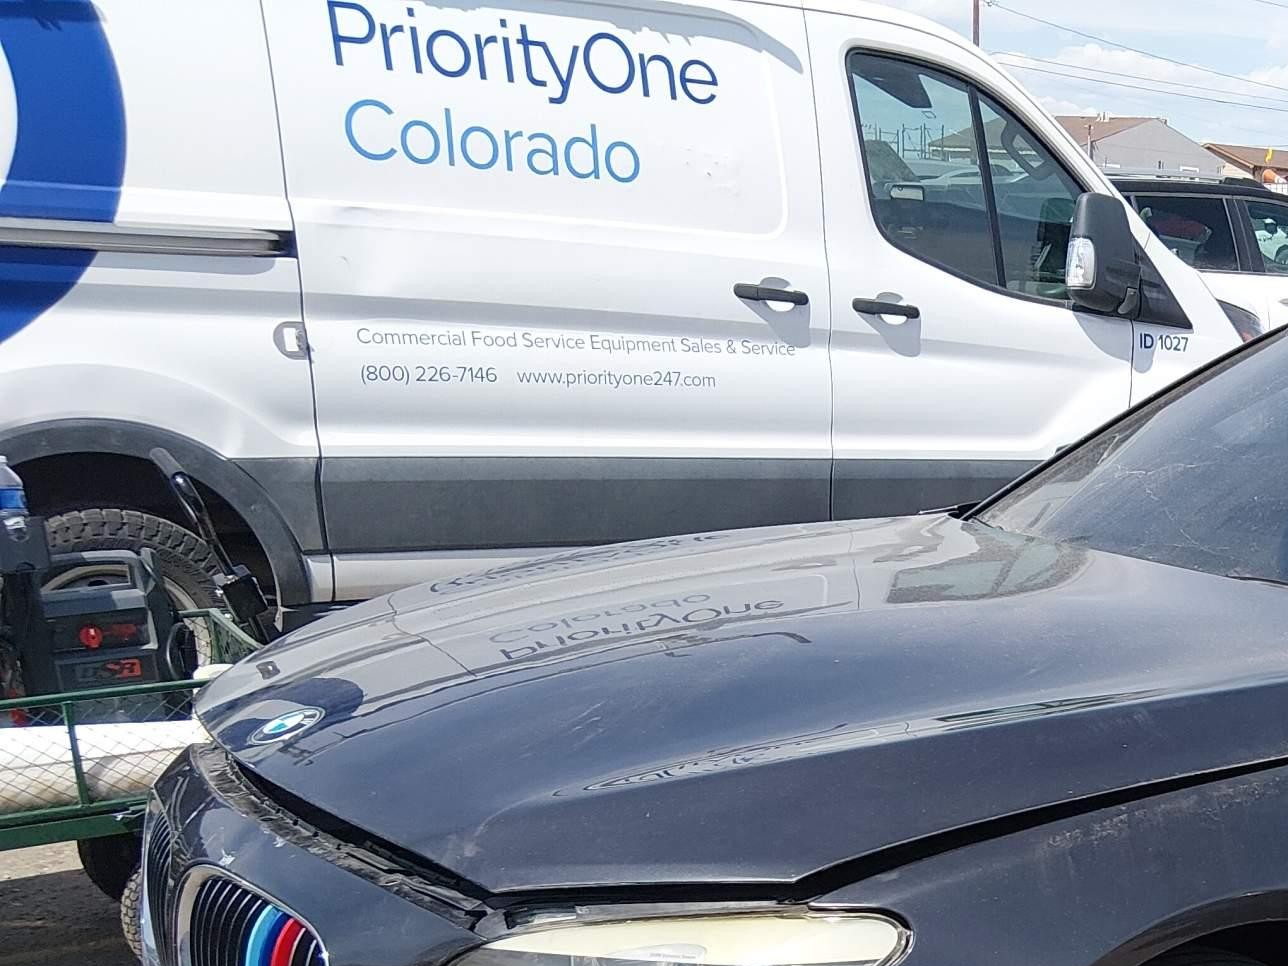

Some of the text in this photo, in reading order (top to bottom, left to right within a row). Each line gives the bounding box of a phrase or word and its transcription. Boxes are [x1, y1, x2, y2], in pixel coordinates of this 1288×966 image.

[327, 0, 718, 105] PriorityOne
[345, 98, 640, 183] Colorado
[356, 327, 796, 356] Commercial Food Service Equipment Sales & Service
[1139, 332, 1189, 352] ID 1027
[360, 364, 716, 389] (800) 226-7146 www.priorityone247.com
